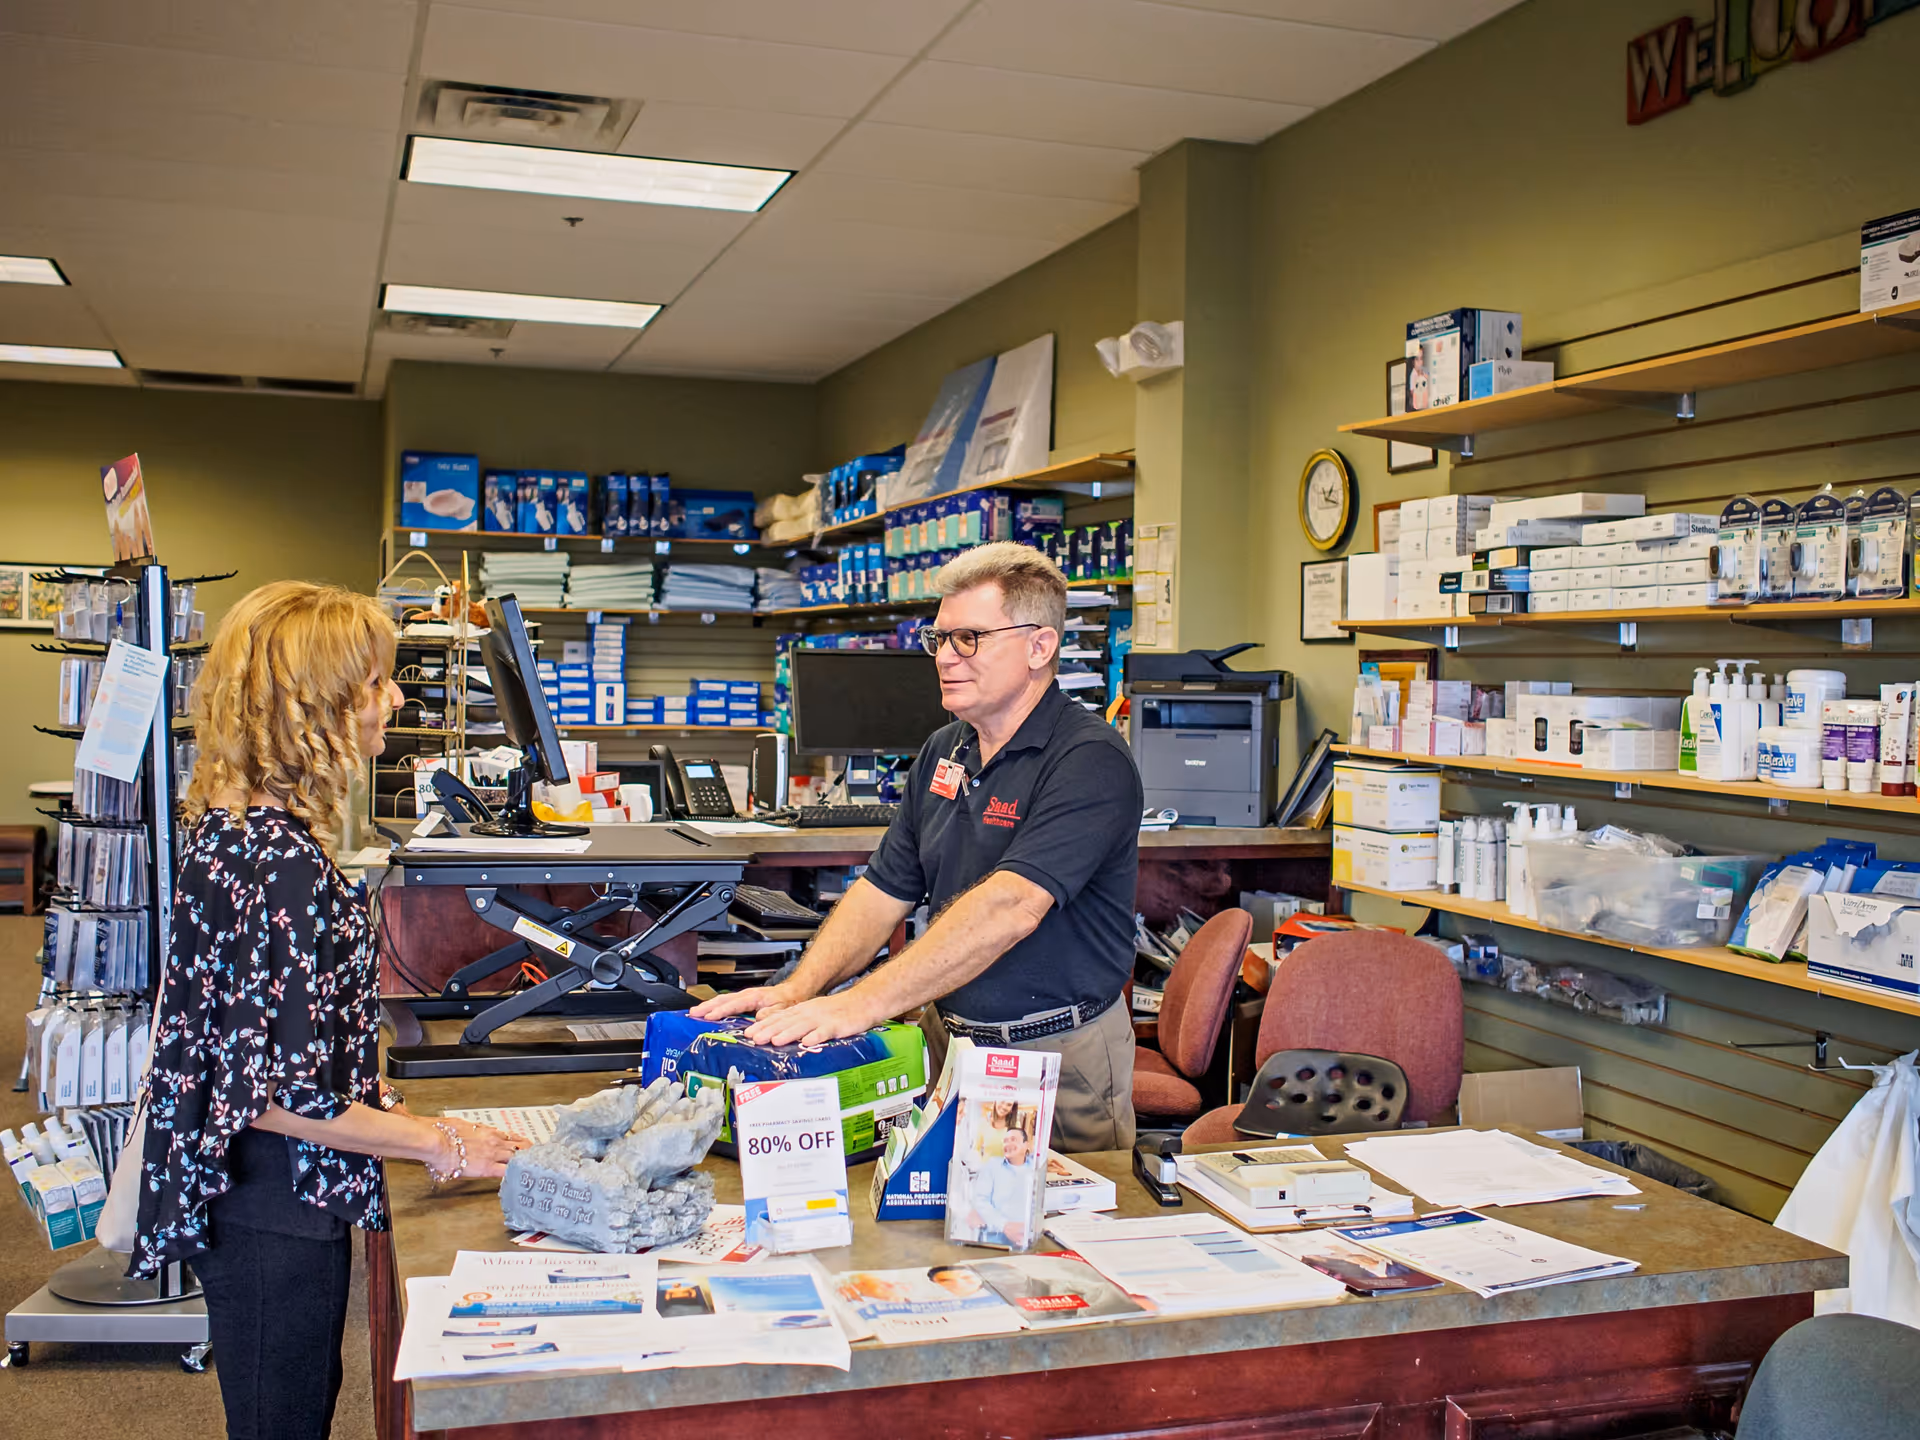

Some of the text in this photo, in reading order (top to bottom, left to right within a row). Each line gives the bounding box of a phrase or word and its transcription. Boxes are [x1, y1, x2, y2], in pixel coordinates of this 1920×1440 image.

[1628, 0, 1876, 116] WELCO
[1786, 694, 1804, 707] eraVe
[1700, 710, 1721, 720] CeraVe
[1758, 752, 1770, 763] Cera
[1770, 753, 1794, 768] CeraVe
[987, 796, 1019, 816] Saad
[991, 1056, 1015, 1066] Saad
[739, 1085, 763, 1104] FREE
[762, 1119, 791, 1127] PHARMACY
[748, 1131, 835, 1156] 80% OFF
[520, 1171, 592, 1202] By His hands
[518, 1193, 595, 1225] we all are fed
